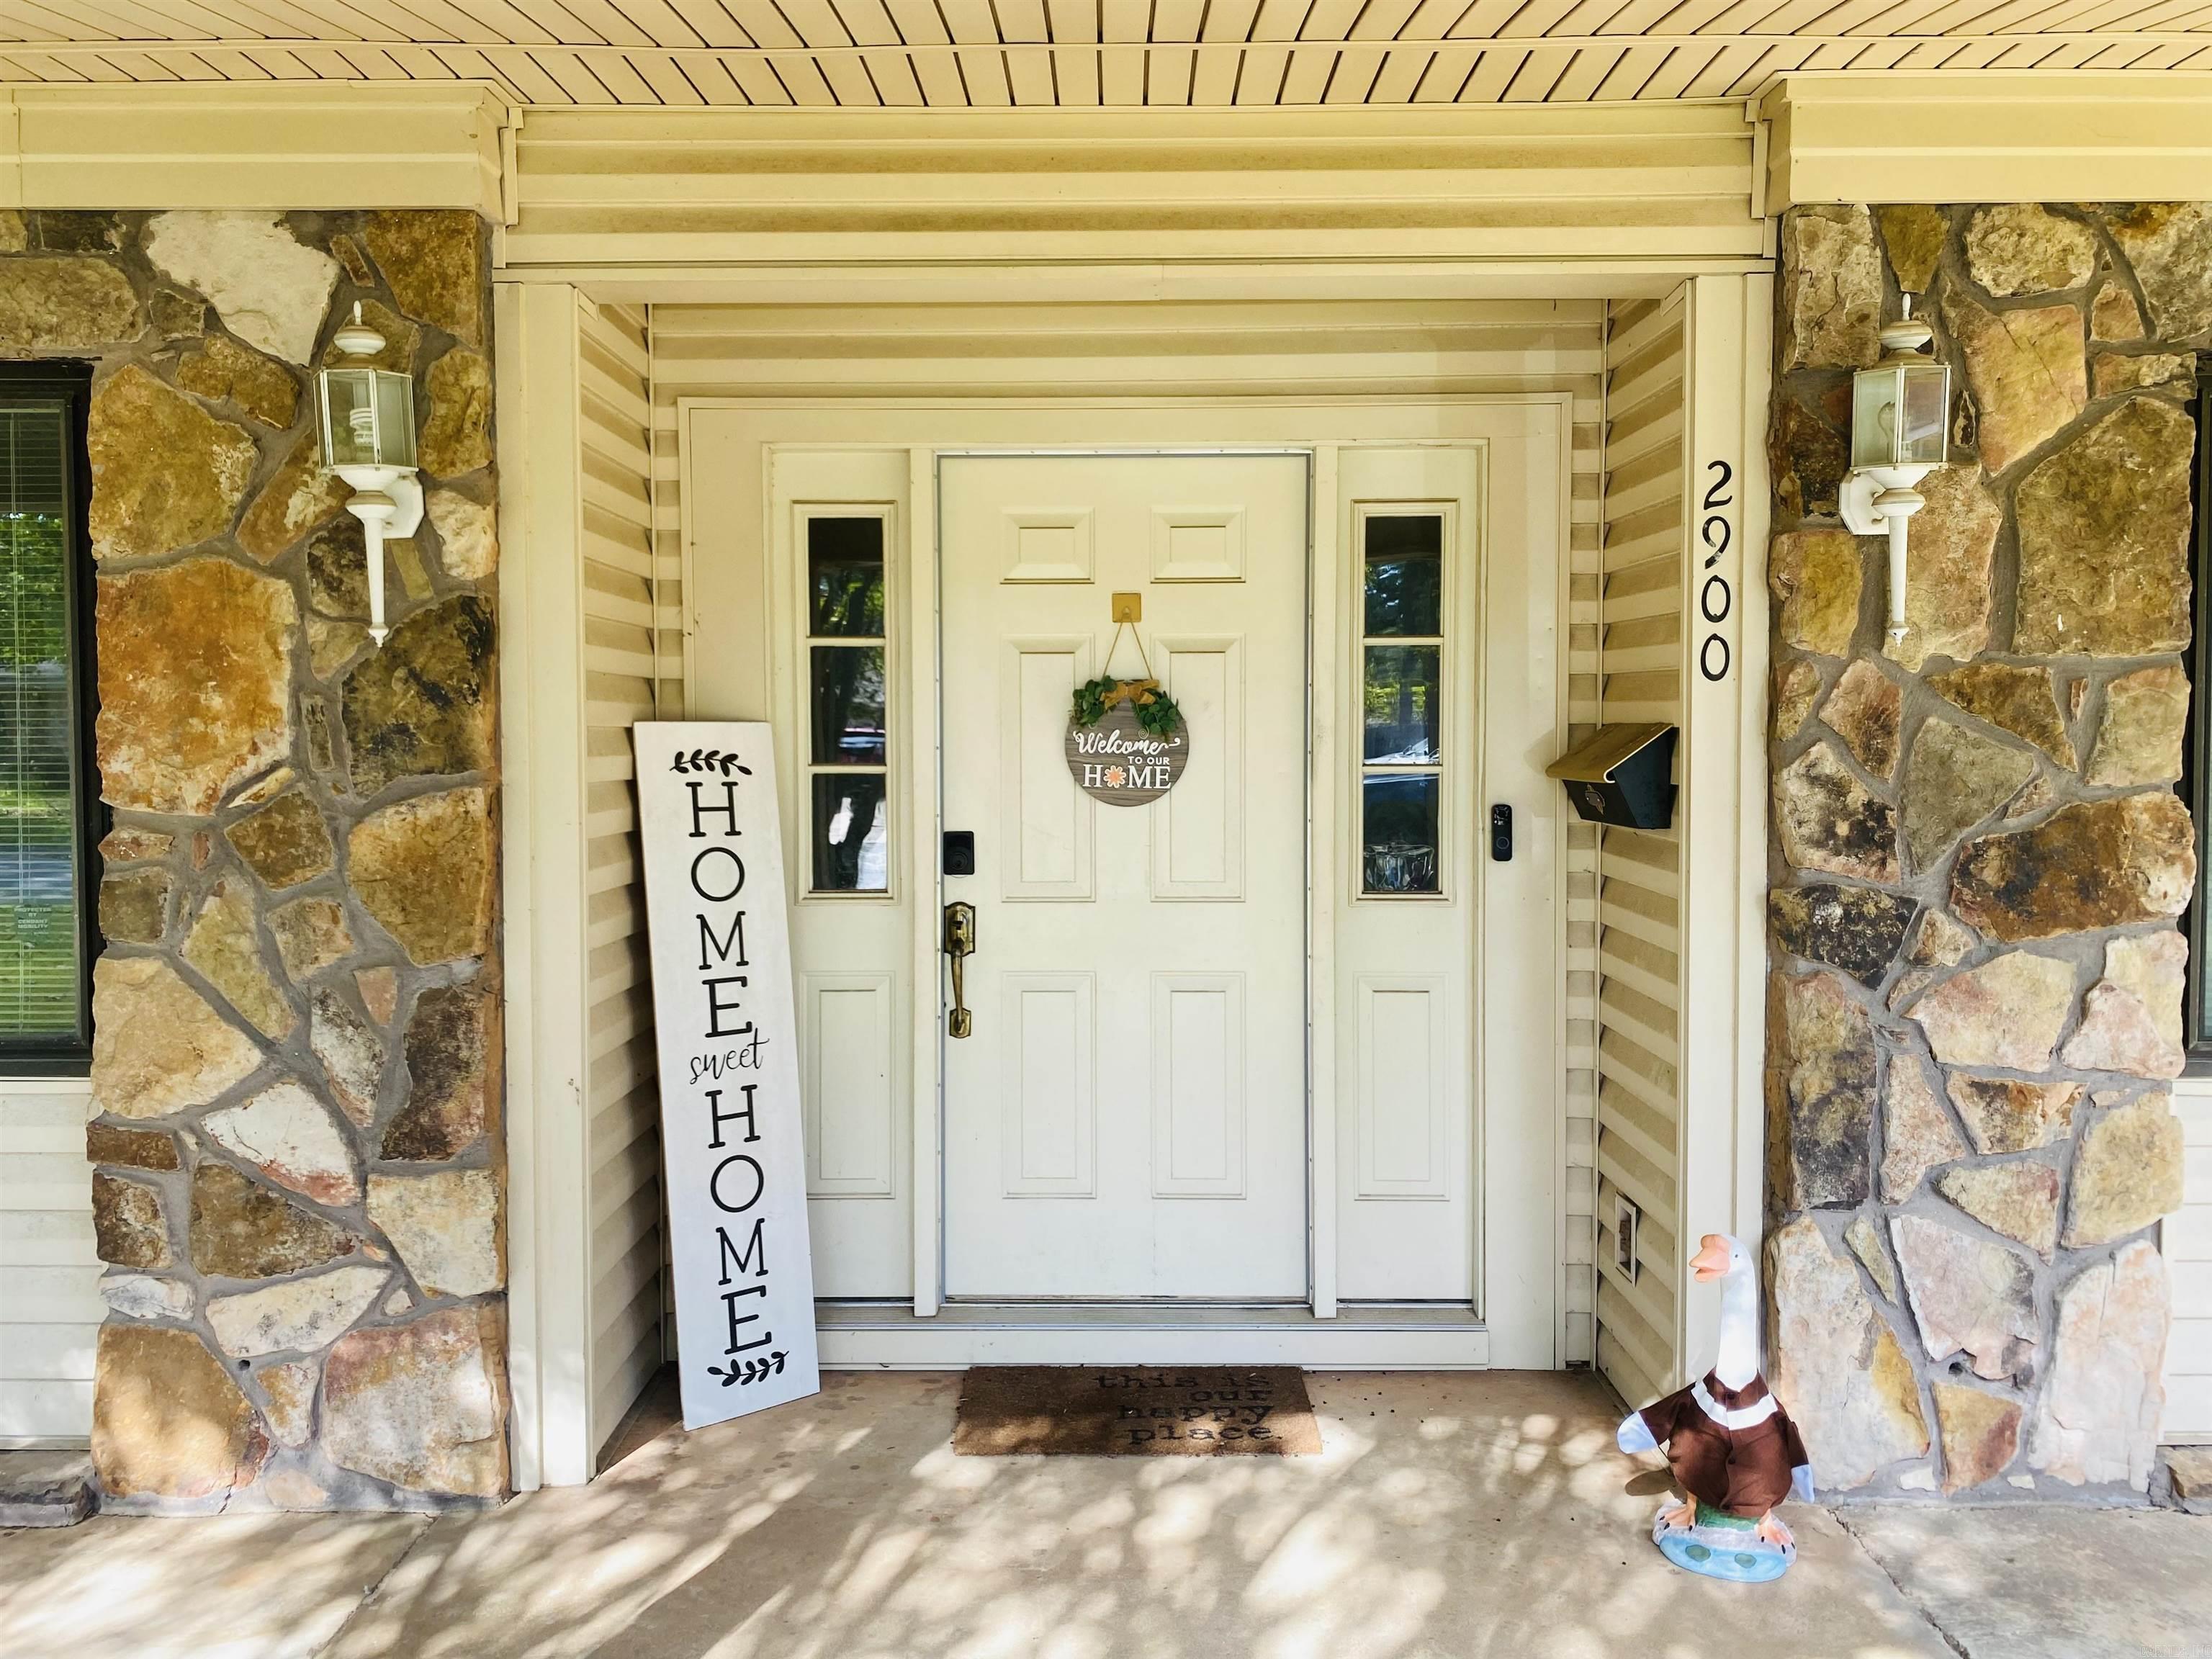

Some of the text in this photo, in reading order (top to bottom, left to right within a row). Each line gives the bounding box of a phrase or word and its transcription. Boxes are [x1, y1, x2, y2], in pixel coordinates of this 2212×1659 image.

[1700, 460, 1732, 682] 2900
[1072, 729, 1181, 755] Welcome
[1128, 756, 1170, 765] TO OUR
[685, 781, 753, 1038] HOME
[689, 1028, 770, 1084] sweet
[705, 1084, 772, 1355] HOME
[1092, 1373, 1270, 1389] this is
[1189, 1390, 1273, 1402] our
[1116, 1405, 1274, 1425] happy
